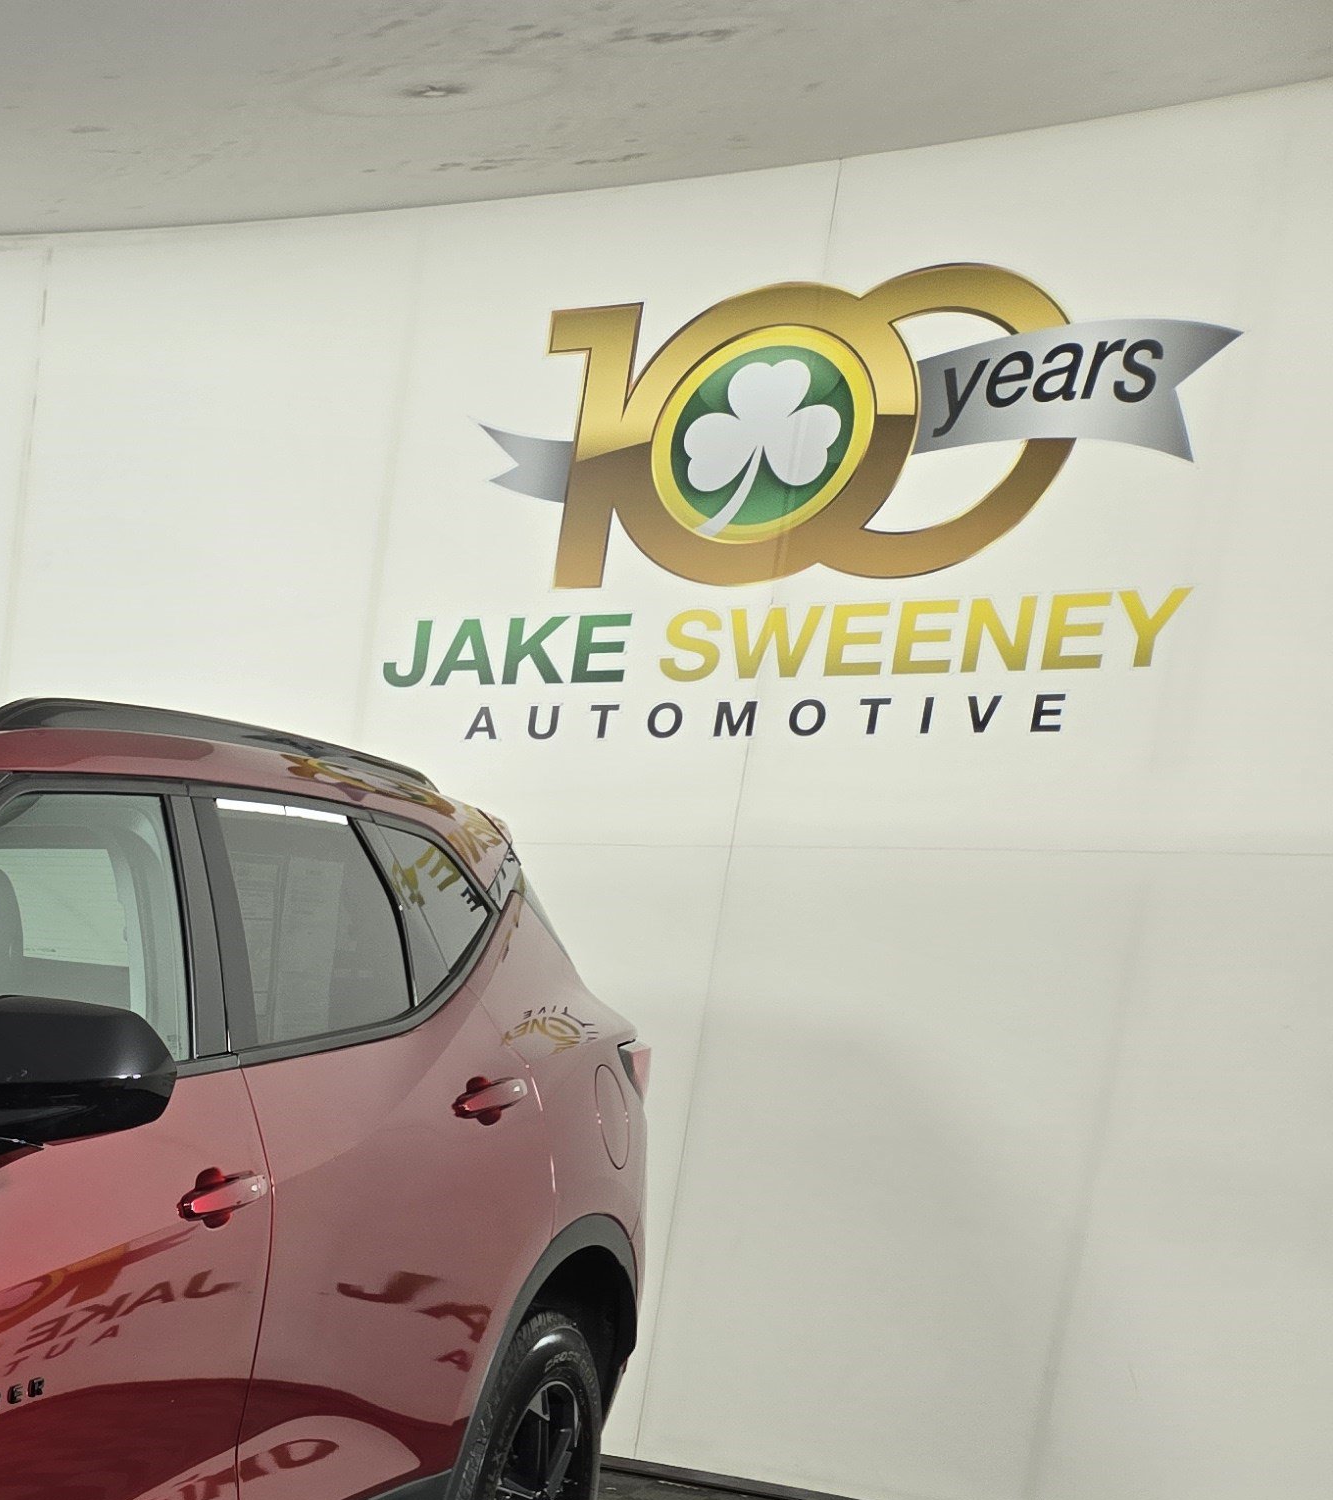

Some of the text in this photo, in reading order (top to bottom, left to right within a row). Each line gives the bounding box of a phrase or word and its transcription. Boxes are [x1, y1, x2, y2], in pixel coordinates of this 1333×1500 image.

[547, 262, 1077, 589] 100
[932, 333, 1164, 437] years
[382, 587, 1194, 687] JAKE SWEENEY
[464, 692, 1068, 741] AUTOMOTIVE
